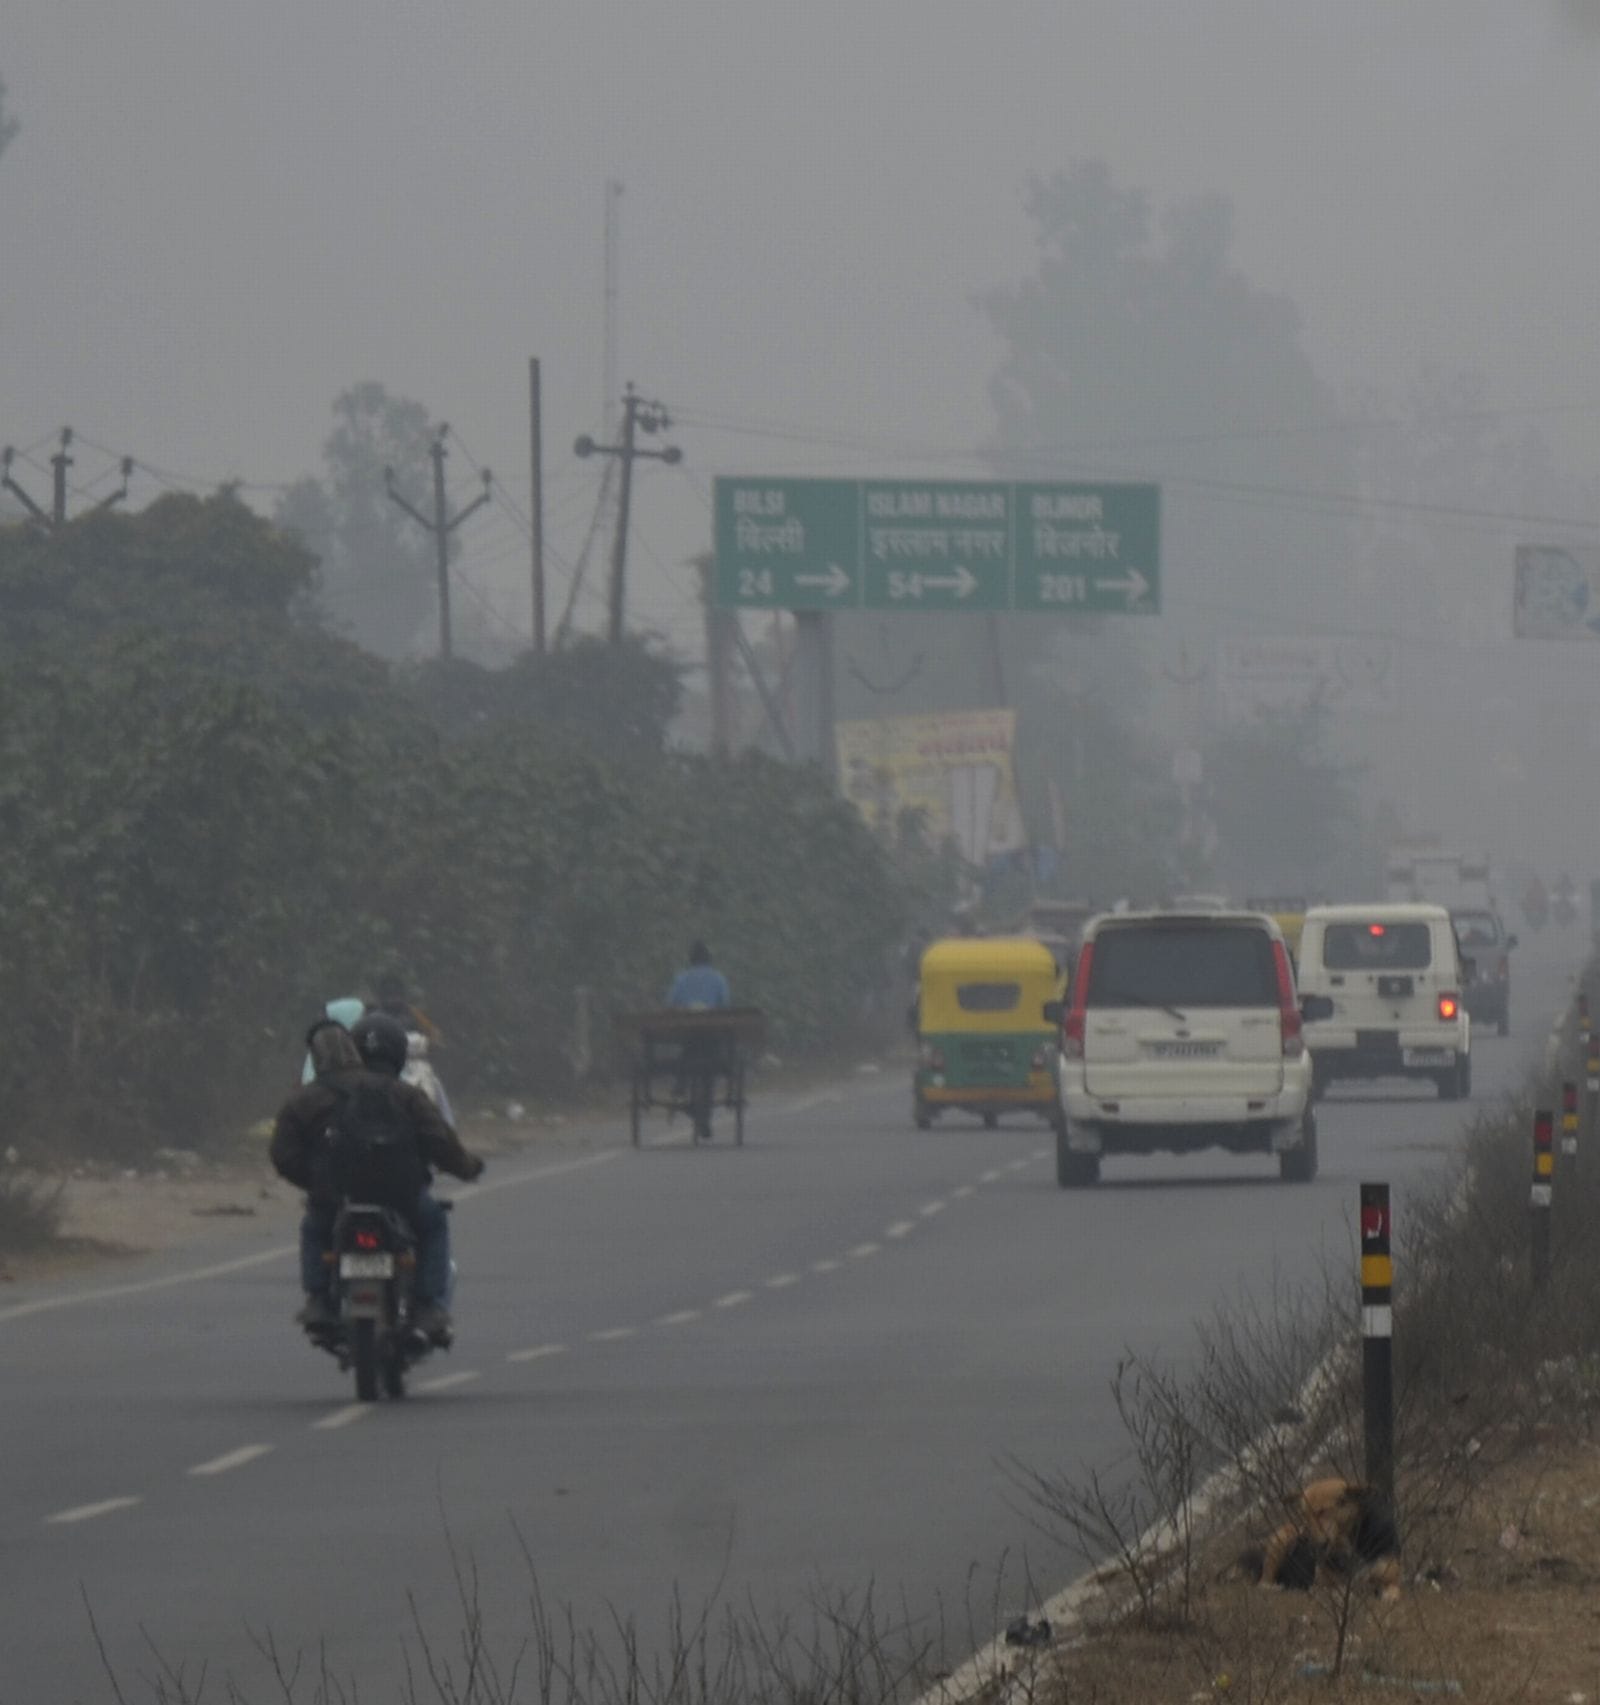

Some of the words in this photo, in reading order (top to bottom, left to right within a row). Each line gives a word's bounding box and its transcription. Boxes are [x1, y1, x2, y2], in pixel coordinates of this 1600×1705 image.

[734, 488, 786, 515] BILSI
[867, 490, 932, 518] ISLAM
[935, 492, 1005, 520] NAGAR
[734, 515, 805, 553] बिल्सी
[869, 527, 949, 563] इस्लाम
[951, 528, 1006, 561] नगर
[738, 568, 773, 596] 24
[887, 571, 923, 600] 54
[1040, 572, 1086, 602] 201
